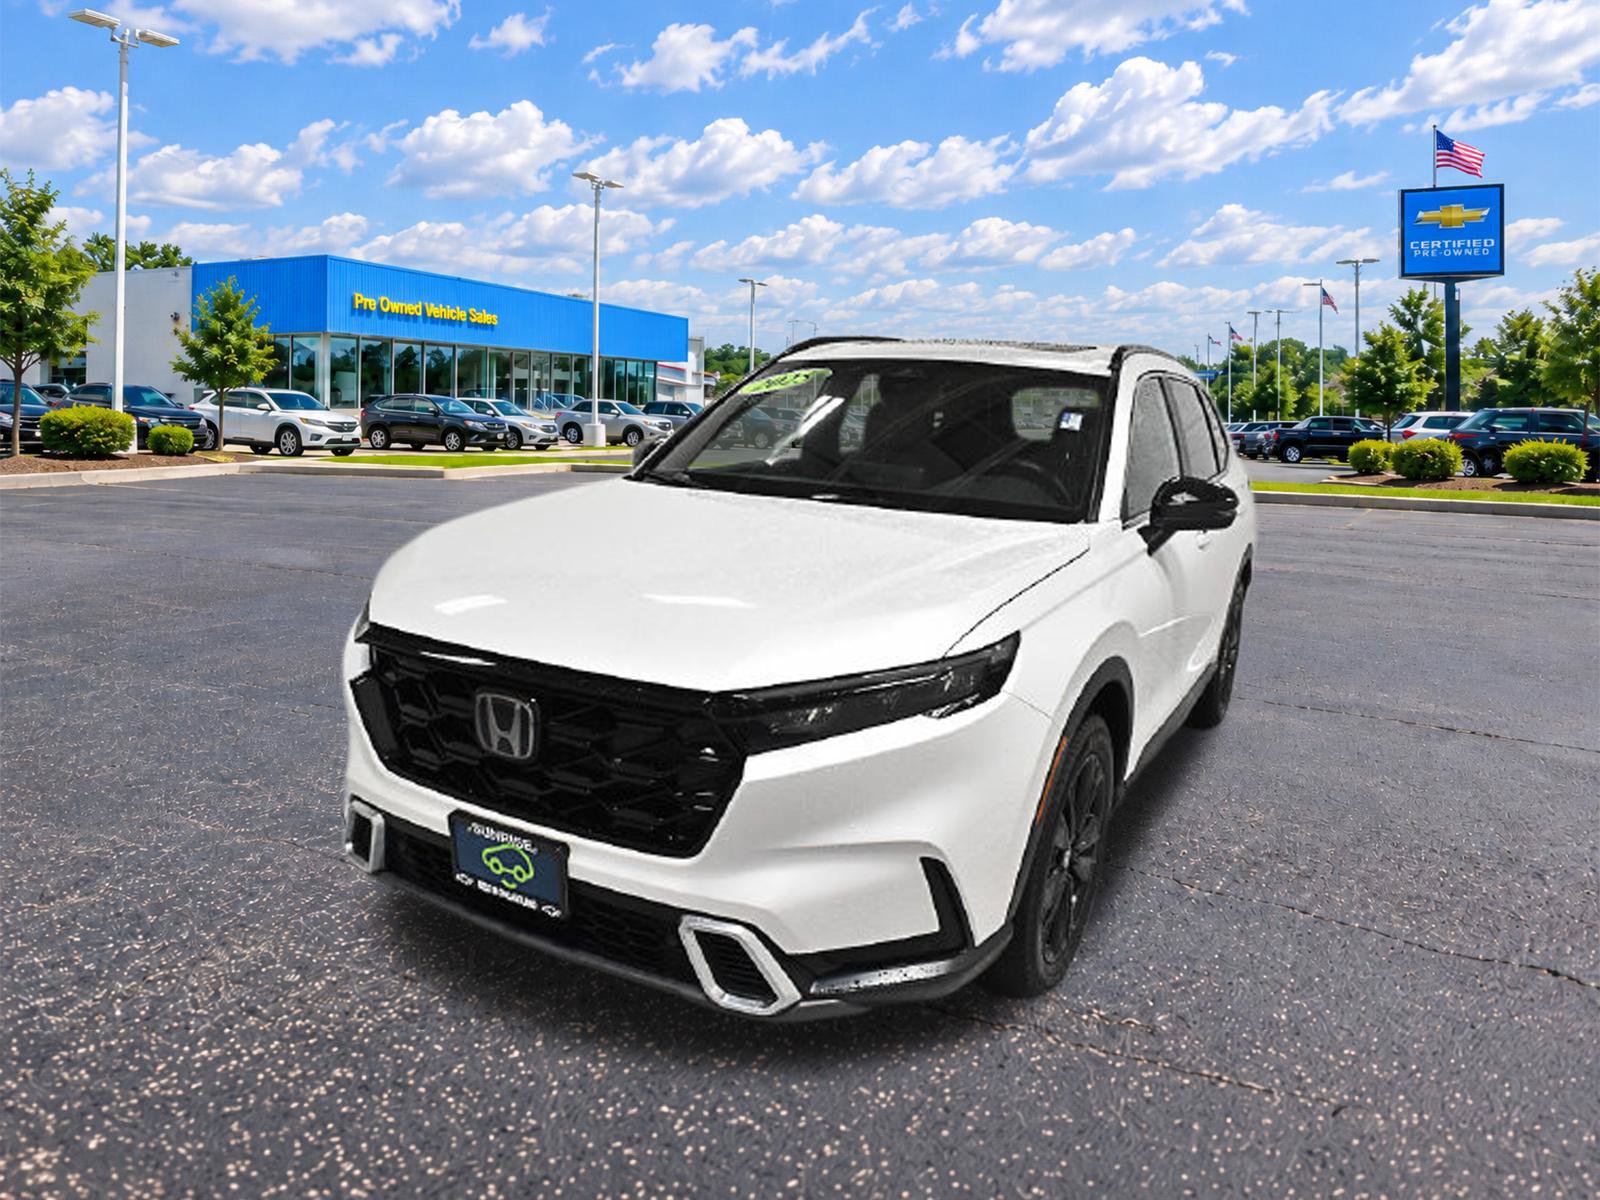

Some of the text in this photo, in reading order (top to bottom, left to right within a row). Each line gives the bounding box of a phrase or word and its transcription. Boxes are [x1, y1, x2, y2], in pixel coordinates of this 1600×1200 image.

[1410, 239, 1495, 249] CERTIFIED
[1413, 248, 1490, 257] PRE-OWNED
[354, 293, 498, 325] Pre Owned Vehicle Sales
